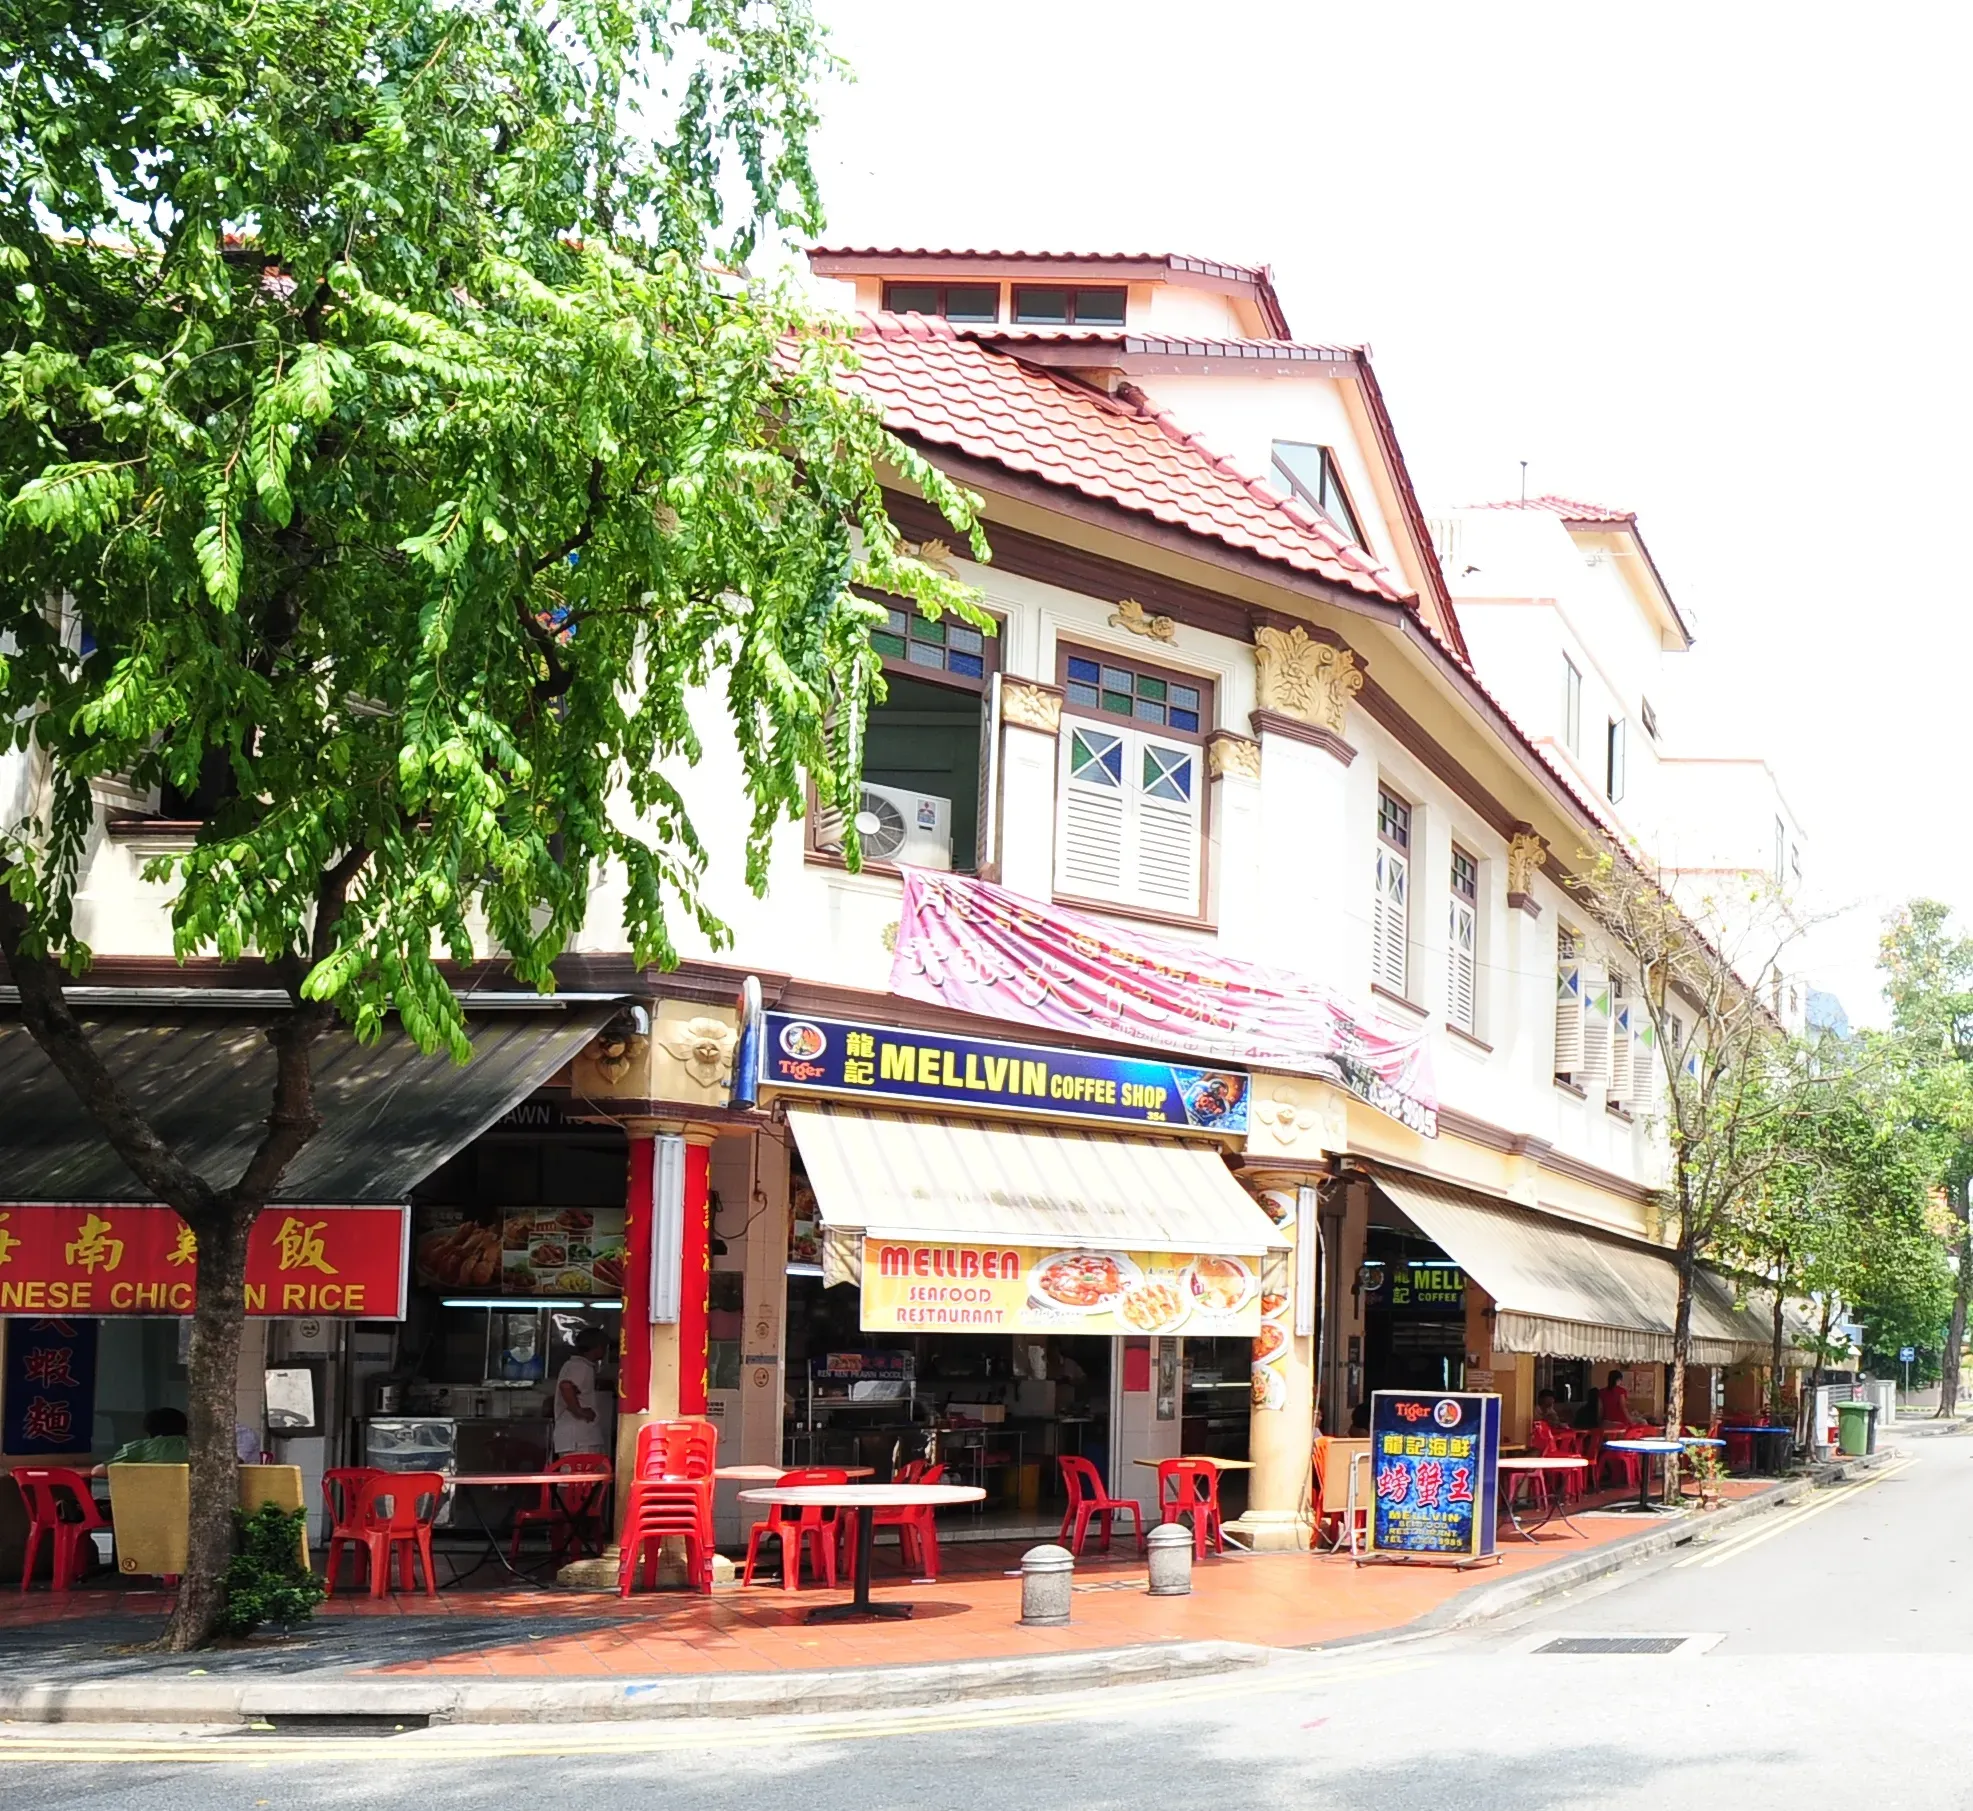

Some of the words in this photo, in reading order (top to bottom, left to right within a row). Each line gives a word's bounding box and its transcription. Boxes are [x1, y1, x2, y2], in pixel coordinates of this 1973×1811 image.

[844, 1032, 875, 1085] 龍記
[779, 1060, 825, 1081] Tiger
[880, 1043, 1047, 1097] MELLVIN
[1051, 1074, 1116, 1105] COFFEE
[1121, 1082, 1167, 1109] SHOP
[880, 1246, 1019, 1280] MELLBEN
[283, 1284, 365, 1311] RICE
[909, 1287, 991, 1302] SEAFOOD
[1418, 1292, 1457, 1302] COFFEE
[896, 1307, 1004, 1324] RESTAURANT
[1395, 1402, 1431, 1422] Tiger
[1383, 1435, 1471, 1458] 龍記海鮮
[1377, 1461, 1473, 1508] 螃蟹王
[1388, 1510, 1461, 1523] MELLVIN
